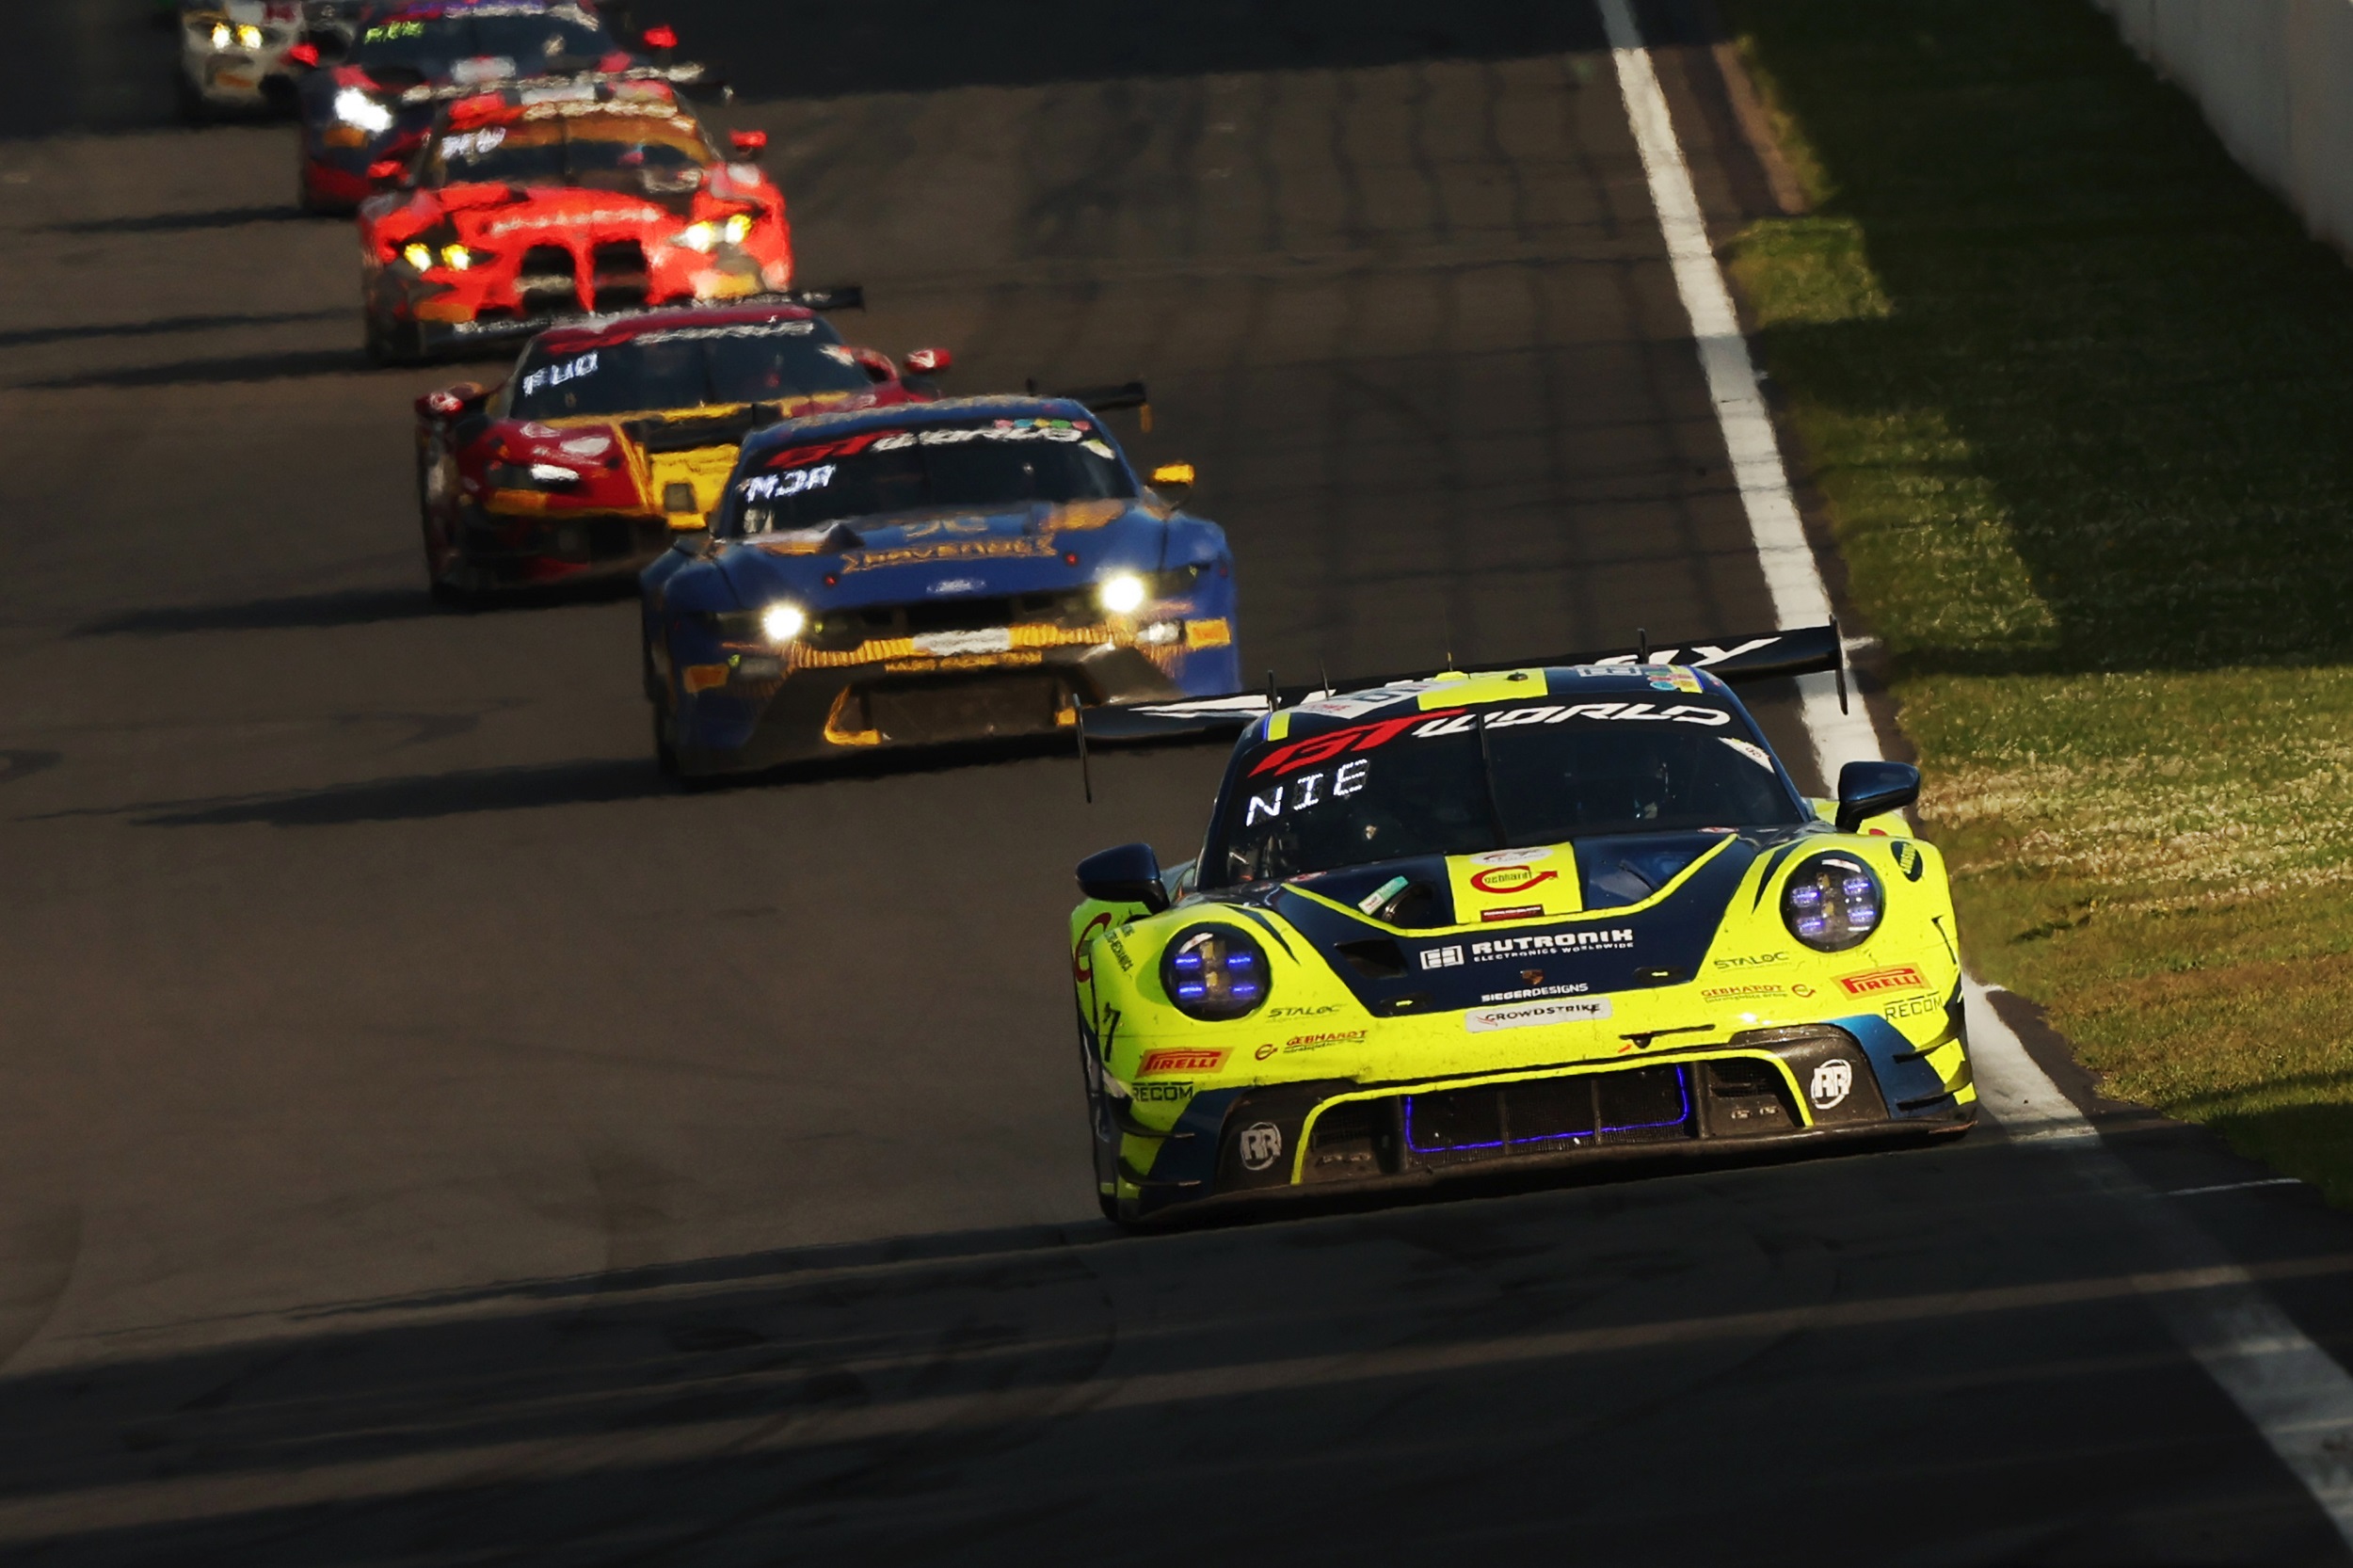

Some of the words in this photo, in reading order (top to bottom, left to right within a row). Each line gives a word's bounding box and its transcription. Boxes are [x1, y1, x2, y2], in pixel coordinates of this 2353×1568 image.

[1247, 708, 1468, 778] GT
[1411, 703, 1731, 738] WORLD
[1246, 758, 1368, 826] NIE
[1471, 929, 1634, 955] RUTRONIK
[1473, 947, 1557, 963] ELECTRONICS
[1561, 942, 1635, 953] WORLDWIDE
[1713, 952, 1789, 968] STALOC
[1841, 968, 1922, 994] PIRELLI
[1481, 984, 1589, 1002] SIEGERDESIGNS
[1484, 1002, 1601, 1023] CROWDSTRIKE
[1885, 996, 1944, 1021] RECOM
[1144, 1050, 1222, 1072] PIRELLI
